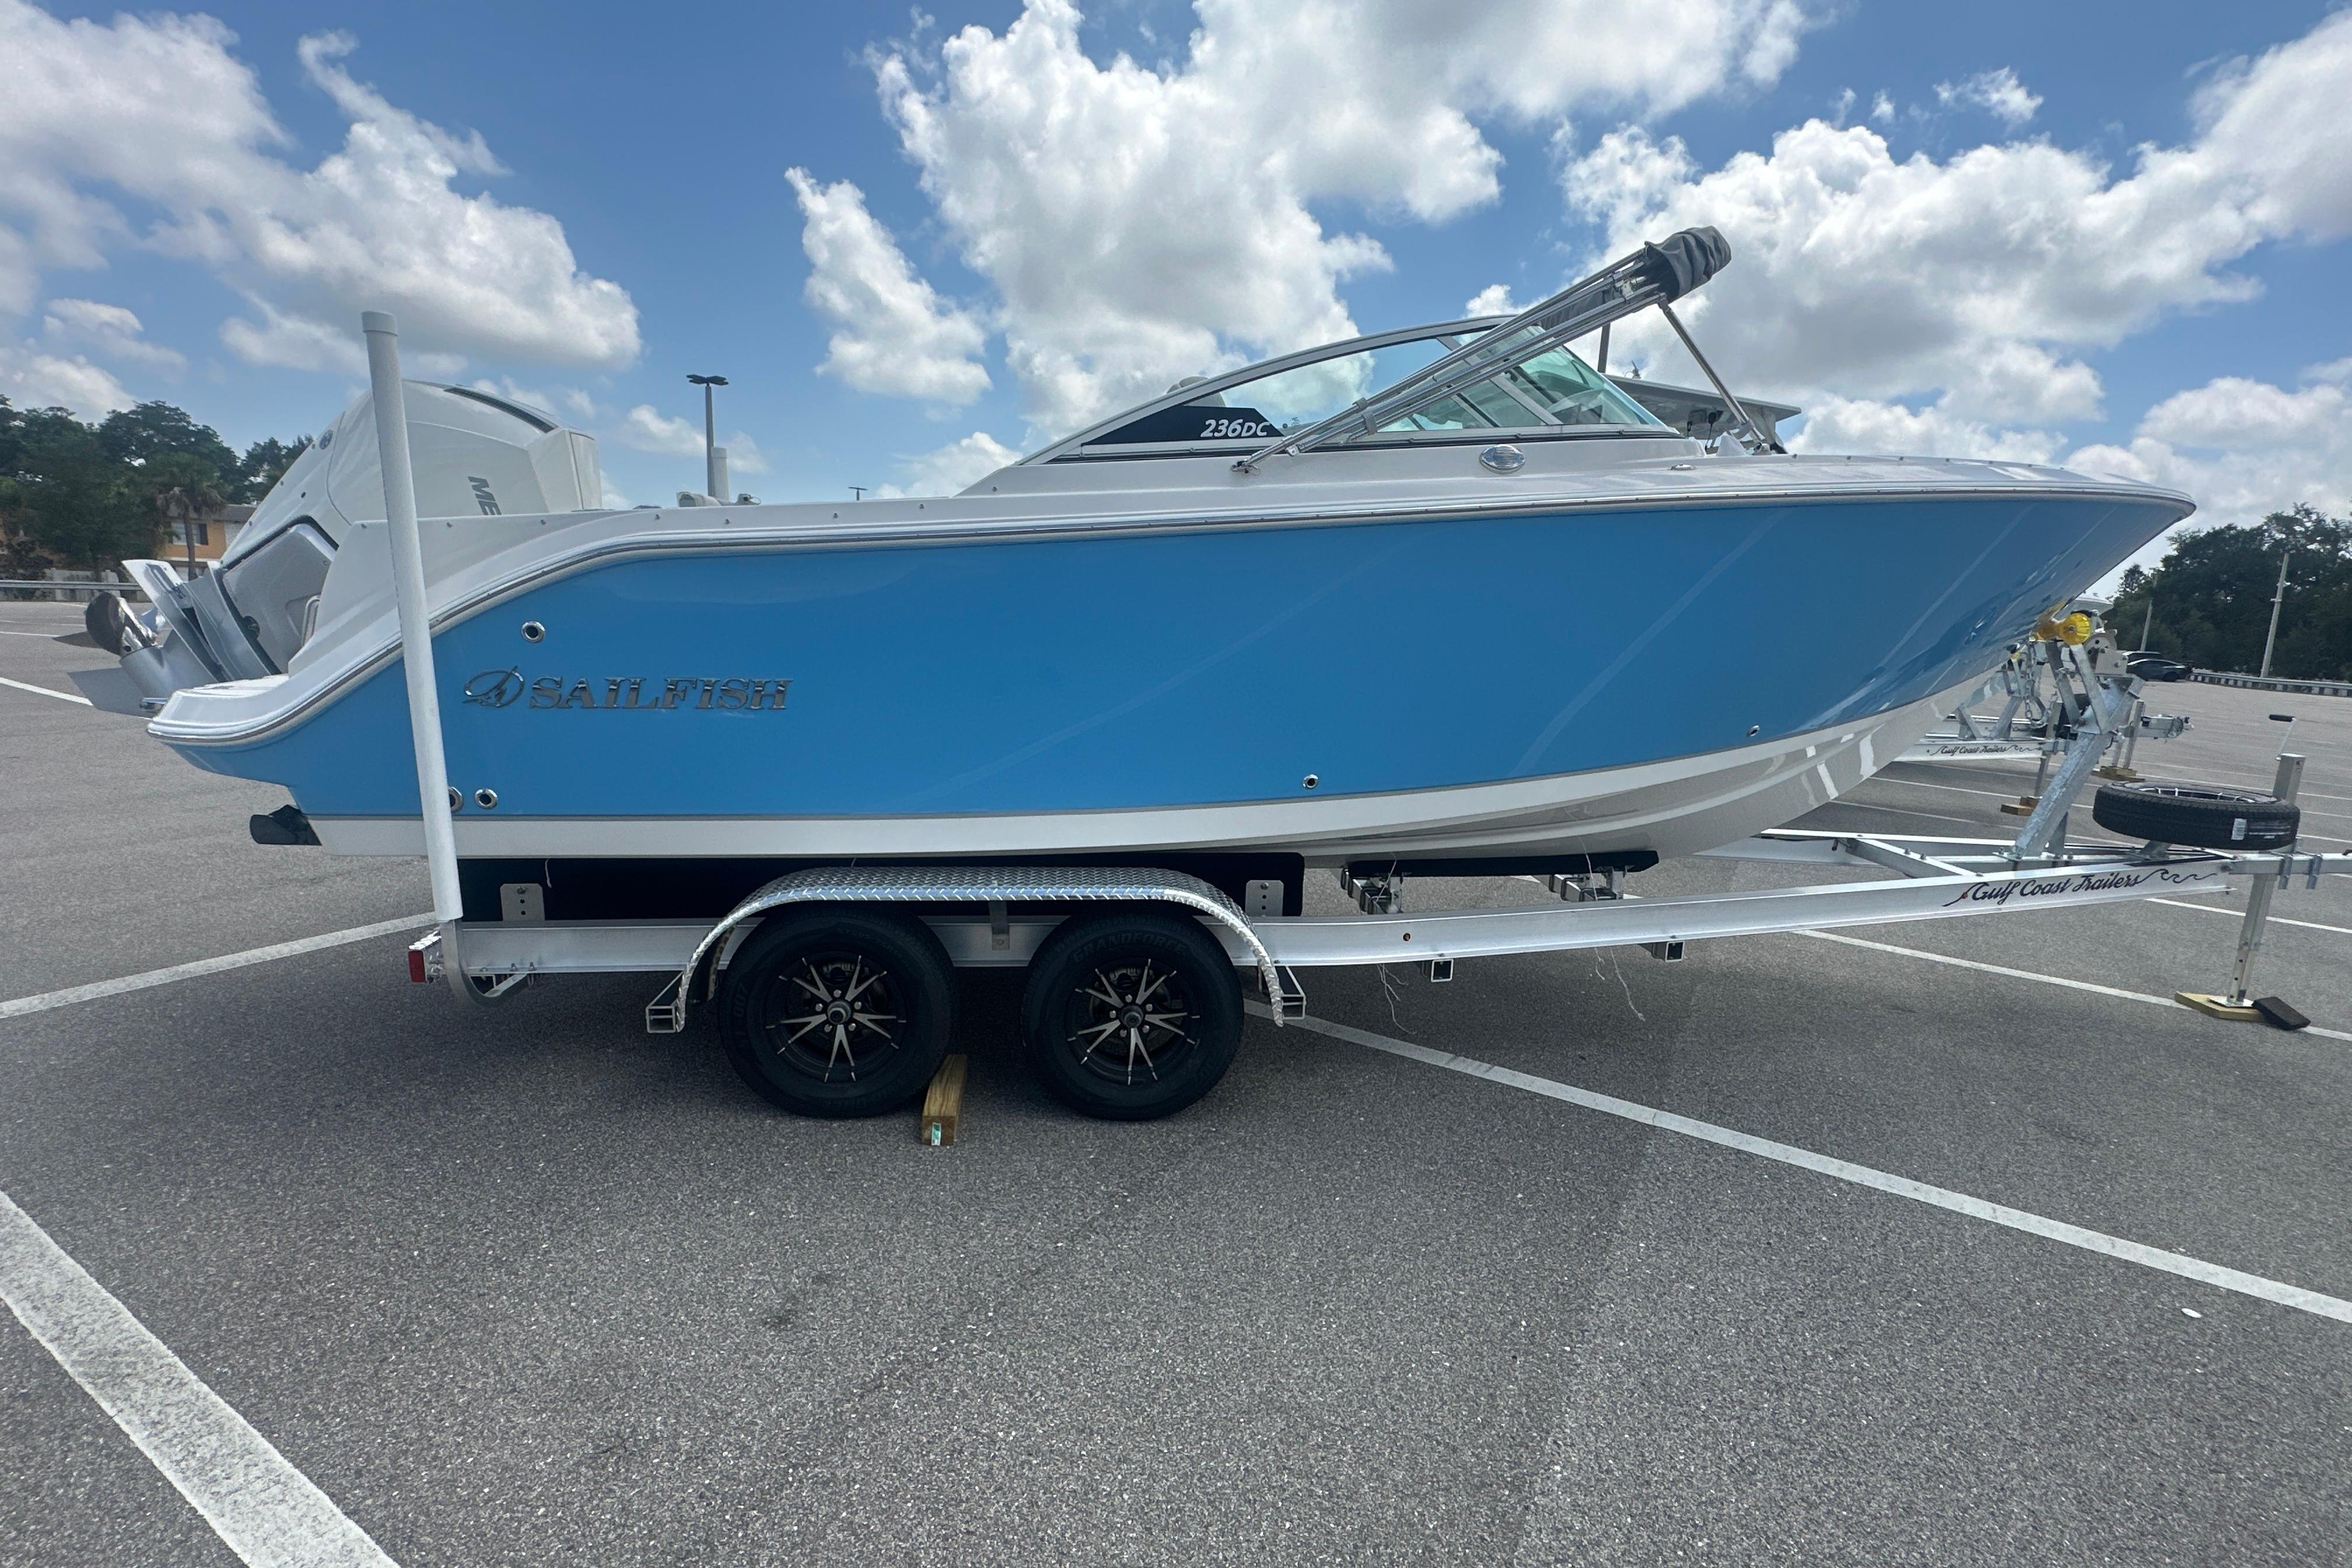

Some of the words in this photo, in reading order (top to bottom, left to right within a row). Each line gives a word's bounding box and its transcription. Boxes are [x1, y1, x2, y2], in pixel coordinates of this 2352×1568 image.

[1200, 419, 1270, 438] 236DC
[529, 677, 794, 710] SAILFISH
[1940, 746, 1959, 756] Gulf
[1968, 881, 2021, 905] Gulf
[2020, 879, 2071, 897] Coast
[2072, 872, 2141, 892] Trailers
